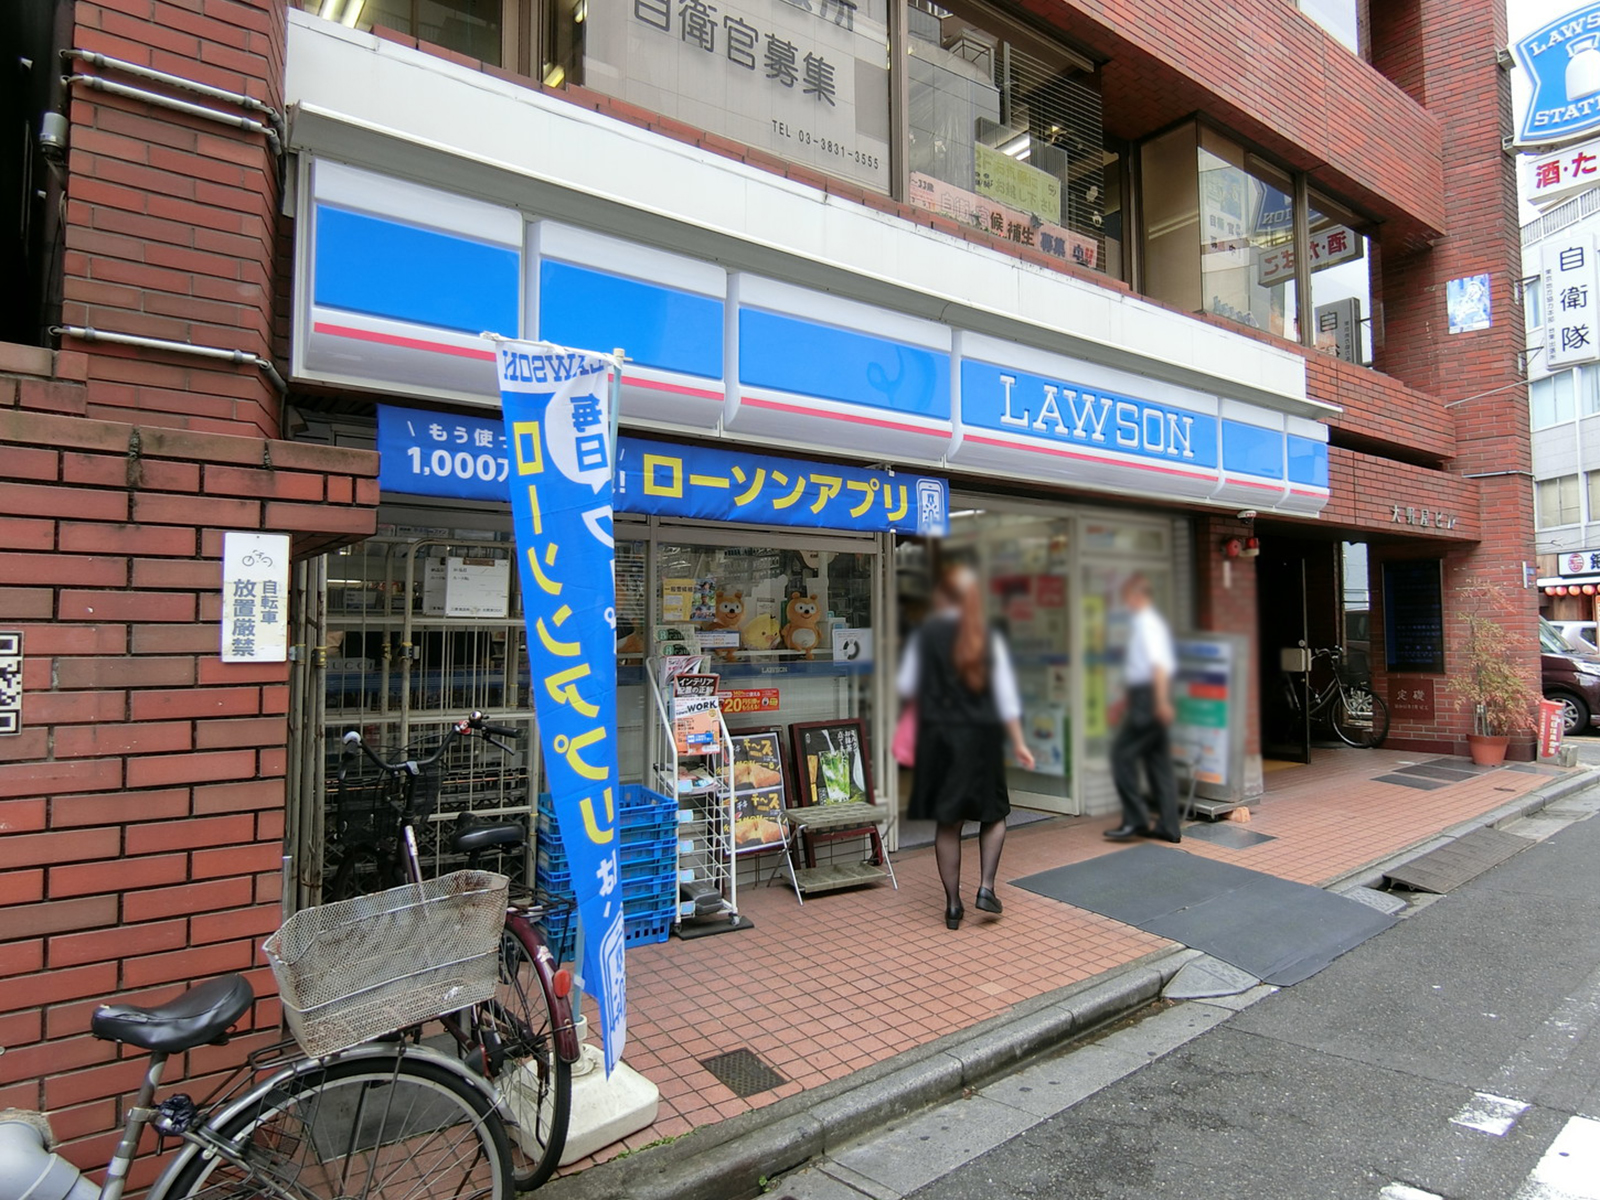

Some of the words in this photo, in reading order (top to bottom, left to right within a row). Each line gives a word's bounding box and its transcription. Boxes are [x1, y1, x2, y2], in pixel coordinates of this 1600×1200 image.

[772, 119, 792, 139] TEL
[798, 129, 880, 171] 03-3831-3555
[1559, 246, 1591, 352] 自衛隊
[999, 374, 1195, 460] LAWSON
[643, 453, 908, 522] ローソンアプリ
[231, 578, 257, 657] 放置厳禁
[260, 580, 279, 625] 自転車
[687, 700, 718, 714] WORK
